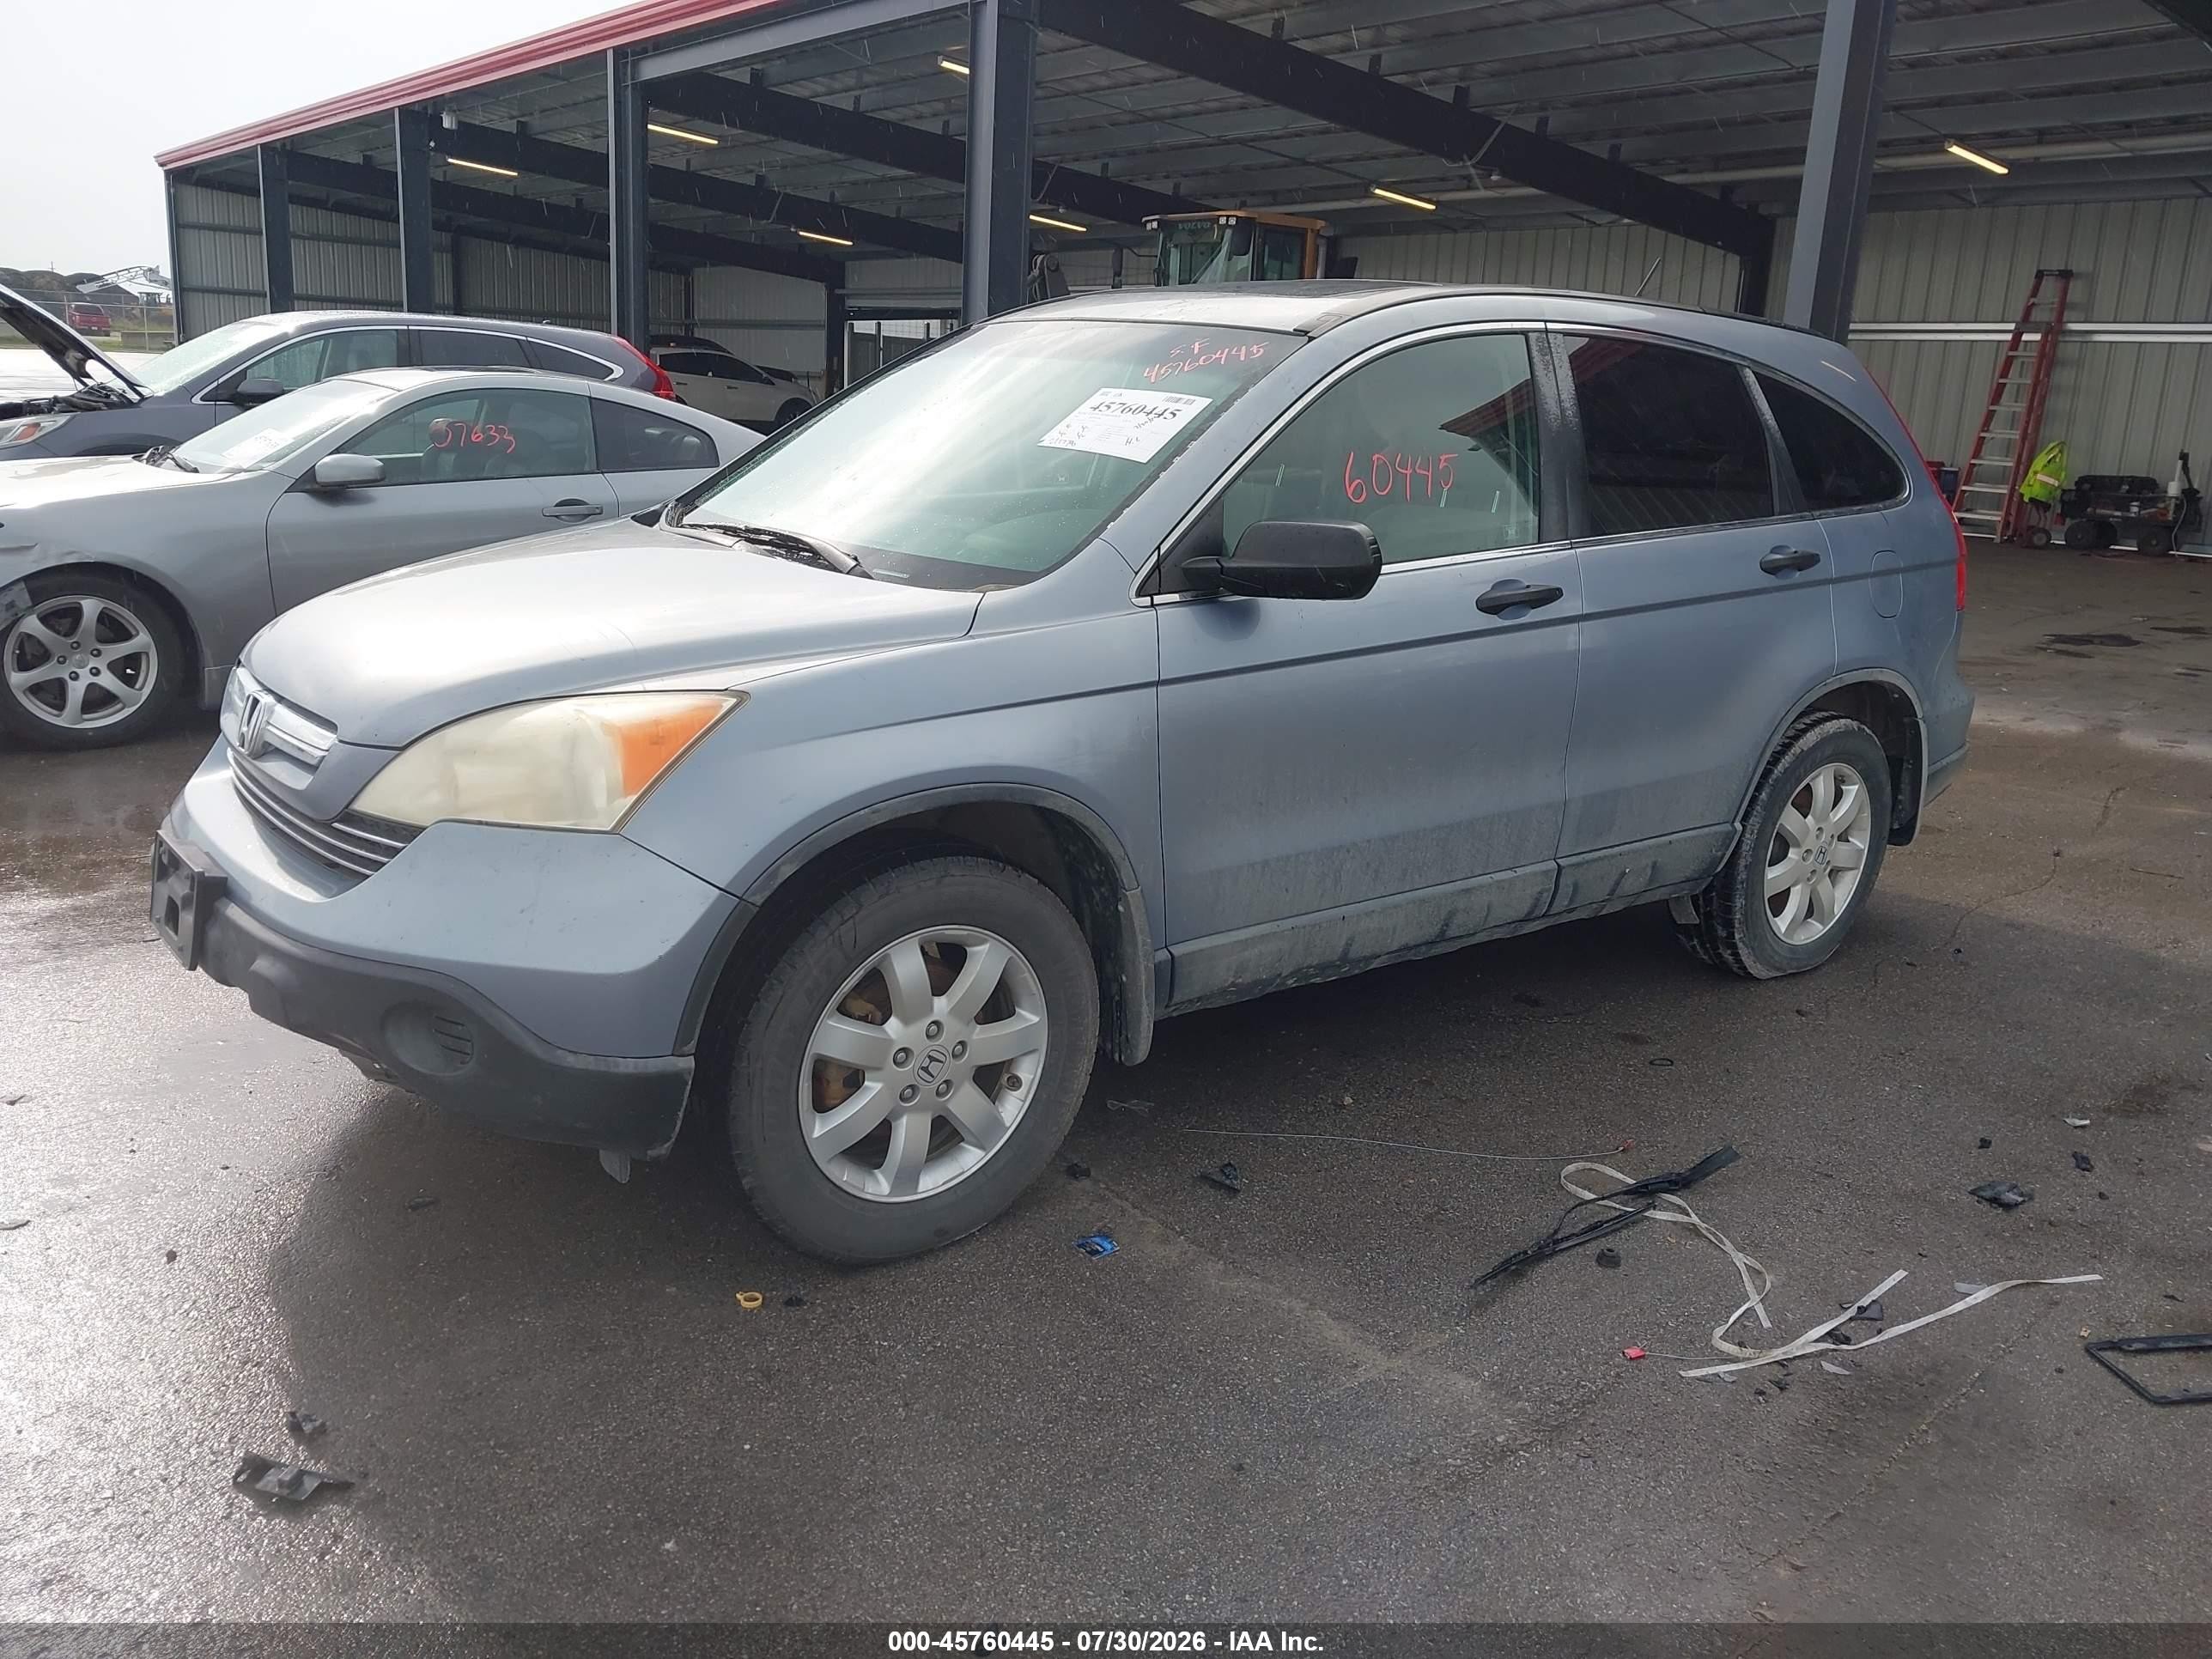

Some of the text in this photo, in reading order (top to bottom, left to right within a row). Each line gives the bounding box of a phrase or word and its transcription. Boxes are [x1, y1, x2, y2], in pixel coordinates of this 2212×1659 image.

[1143, 342, 1269, 384] 45760445
[1090, 401, 1182, 421] 45760445
[1345, 452, 1459, 503] 60445
